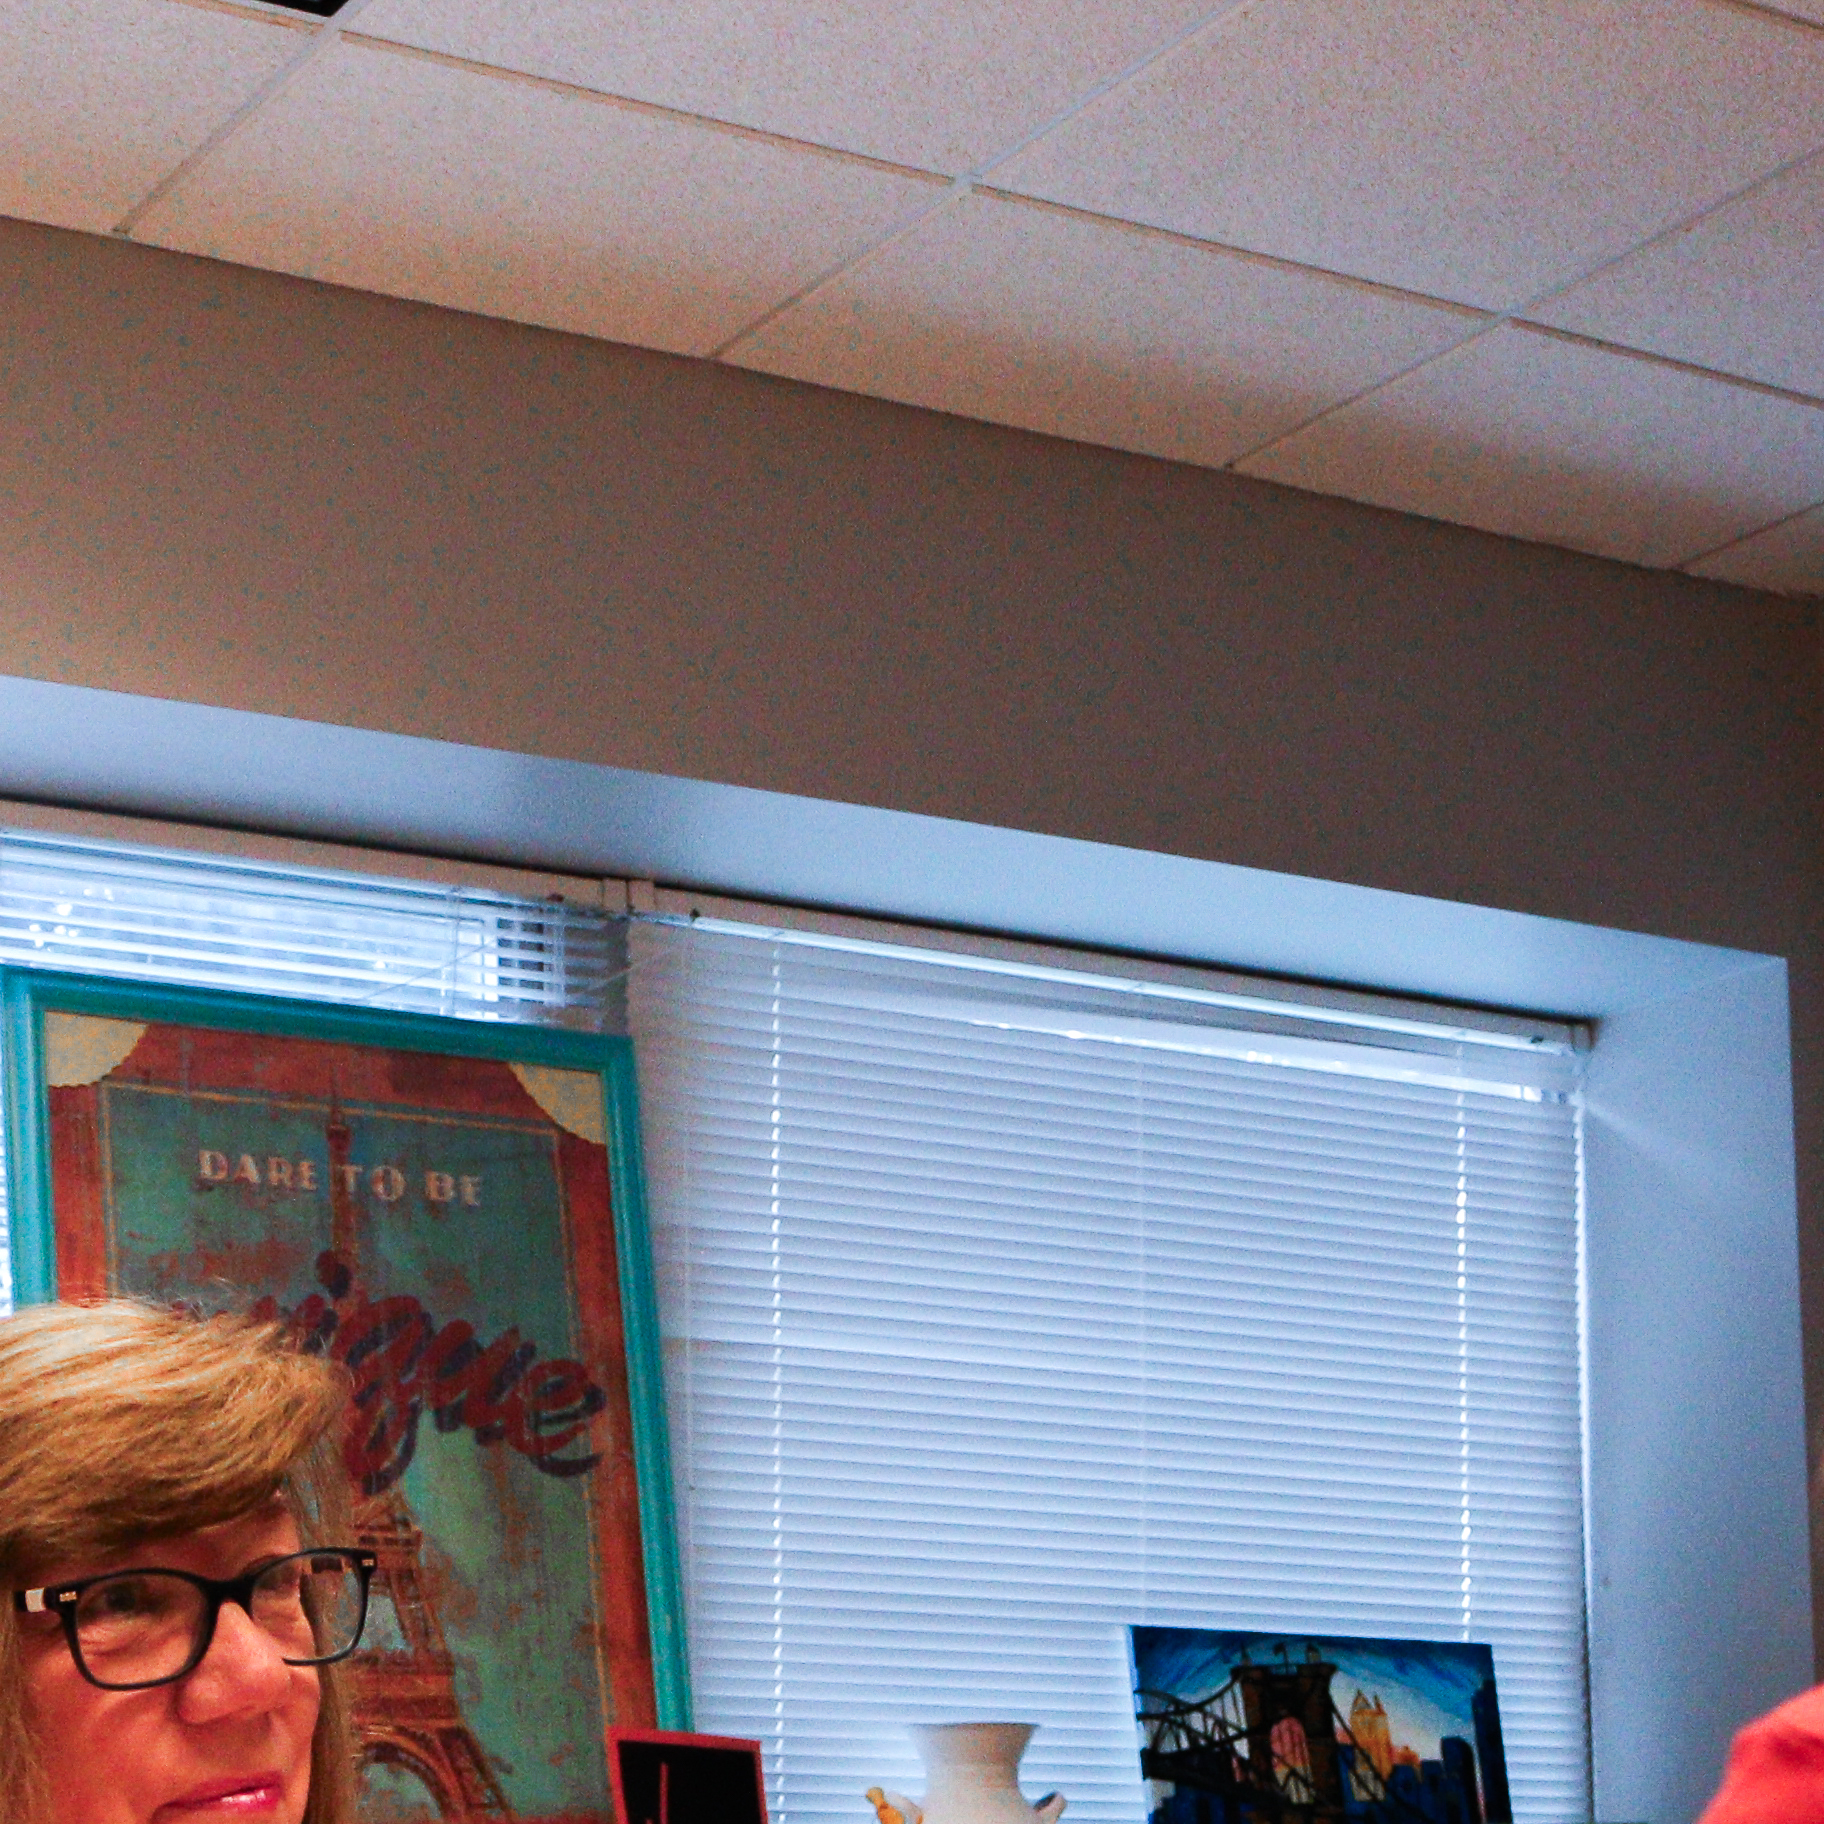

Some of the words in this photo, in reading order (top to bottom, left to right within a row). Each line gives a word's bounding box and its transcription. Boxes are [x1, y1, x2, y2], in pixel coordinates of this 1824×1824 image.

[197, 1149, 319, 1191] DARE
[335, 1163, 407, 1202] TO
[425, 1169, 482, 1207] BE
